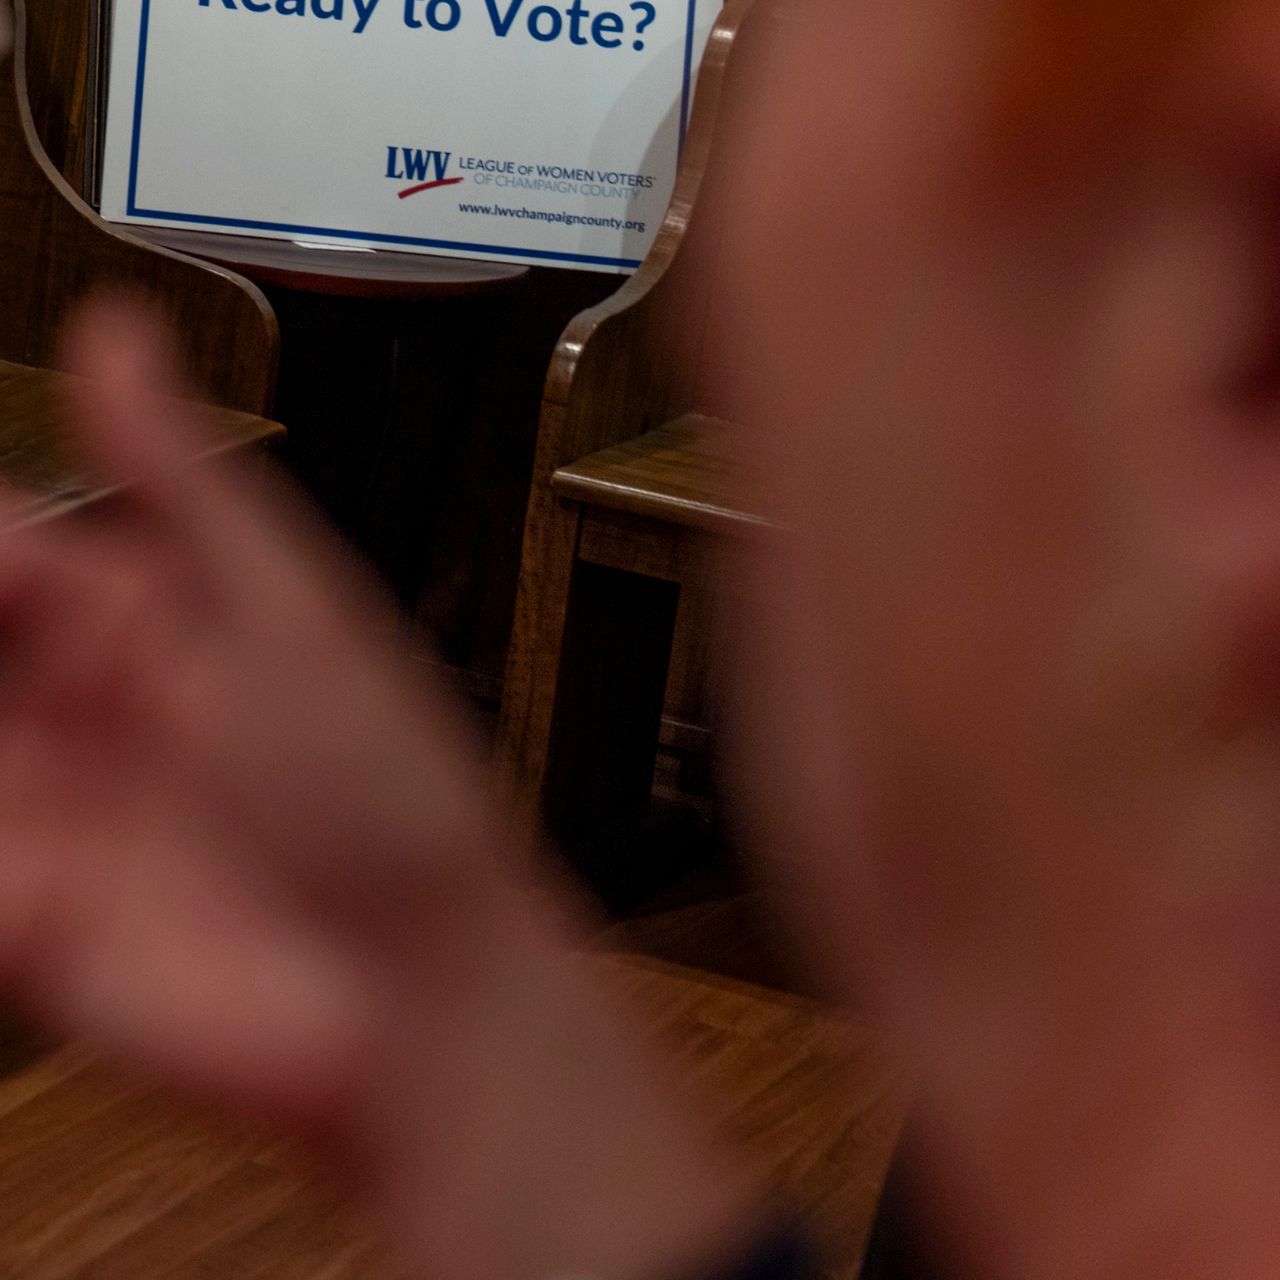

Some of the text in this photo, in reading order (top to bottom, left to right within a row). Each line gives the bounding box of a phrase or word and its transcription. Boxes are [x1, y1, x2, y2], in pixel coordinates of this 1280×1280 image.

[384, 146, 451, 181] LWV
[459, 156, 514, 174] LEAGUE
[517, 164, 534, 176] OF
[536, 164, 593, 182] WOMEN
[473, 172, 641, 200] OF CHAMPAIGN COUNTY
[458, 201, 645, 233] www.lwvchampaigncounty.org
